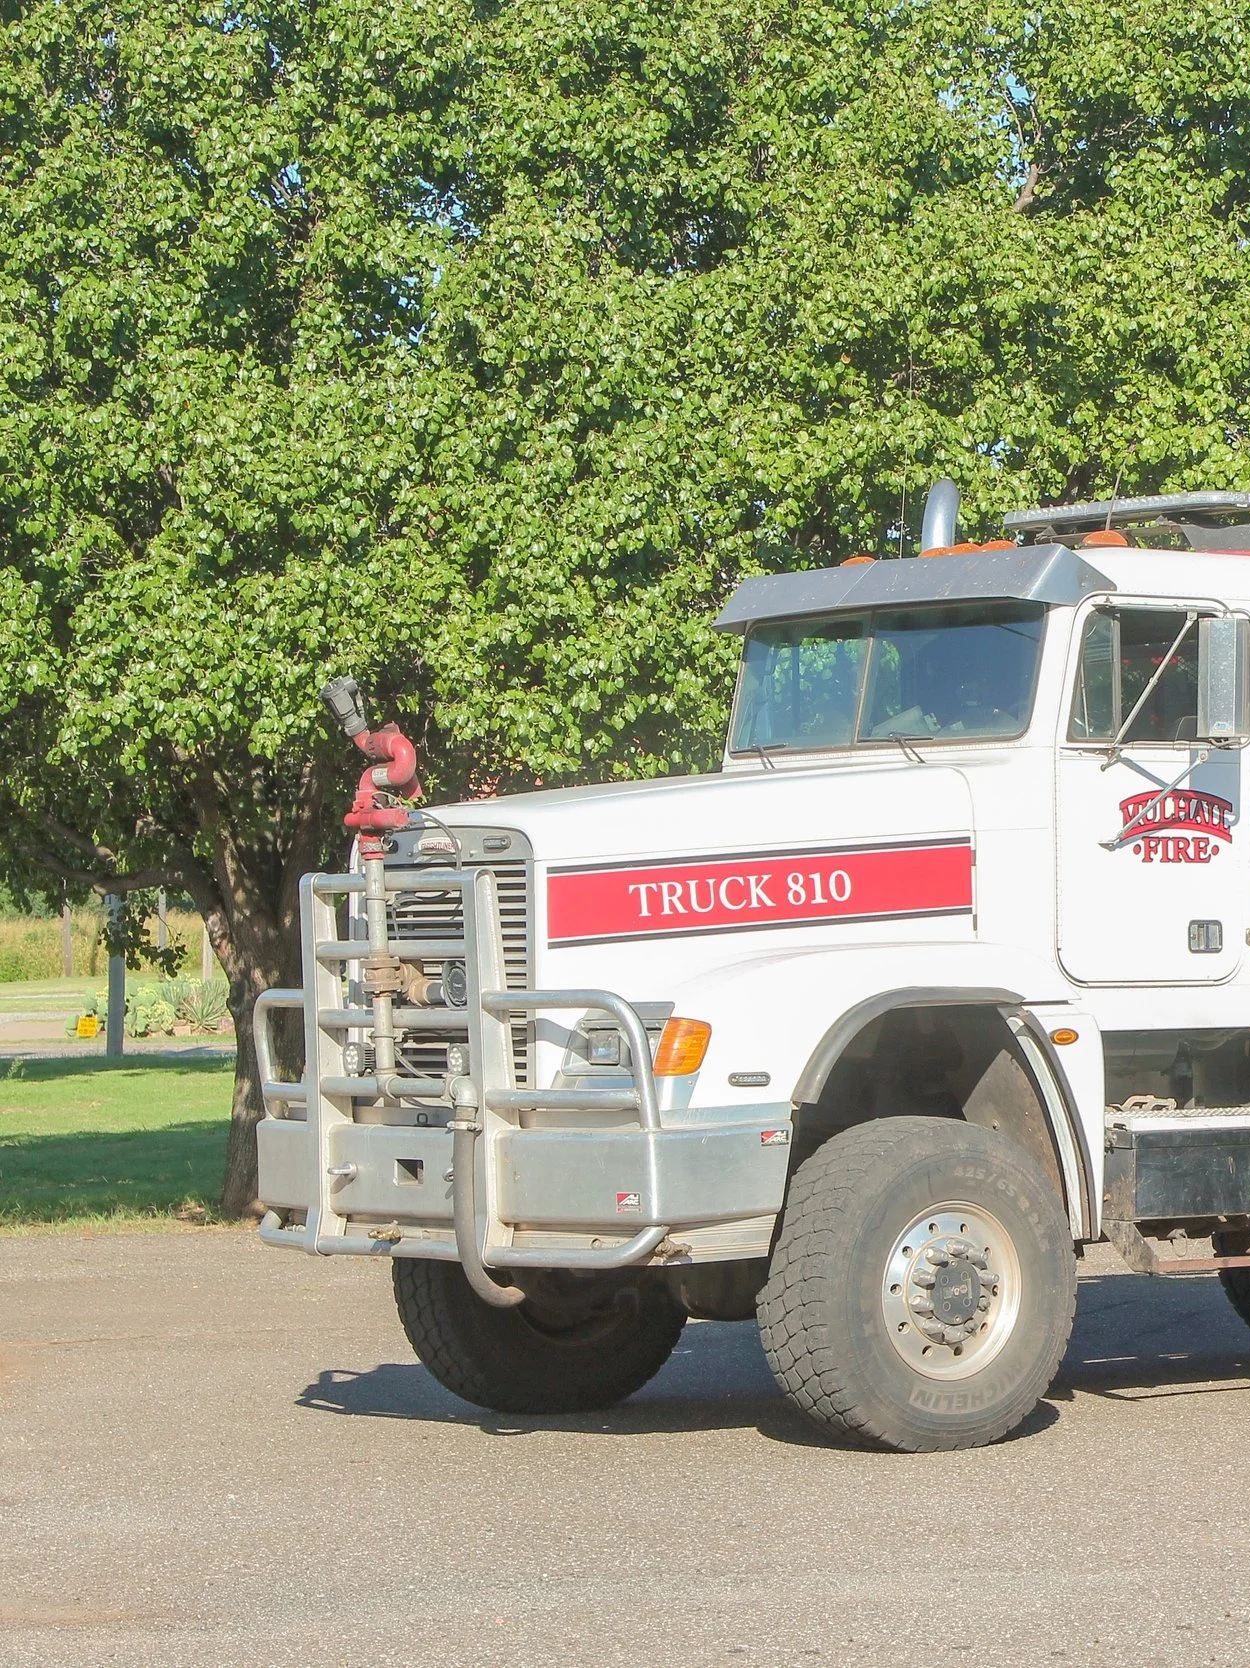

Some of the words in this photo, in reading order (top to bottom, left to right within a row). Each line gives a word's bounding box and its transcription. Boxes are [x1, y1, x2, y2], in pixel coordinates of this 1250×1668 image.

[1141, 836, 1212, 863] FIRE
[628, 874, 777, 918] TRUCK
[786, 869, 852, 906] 810
